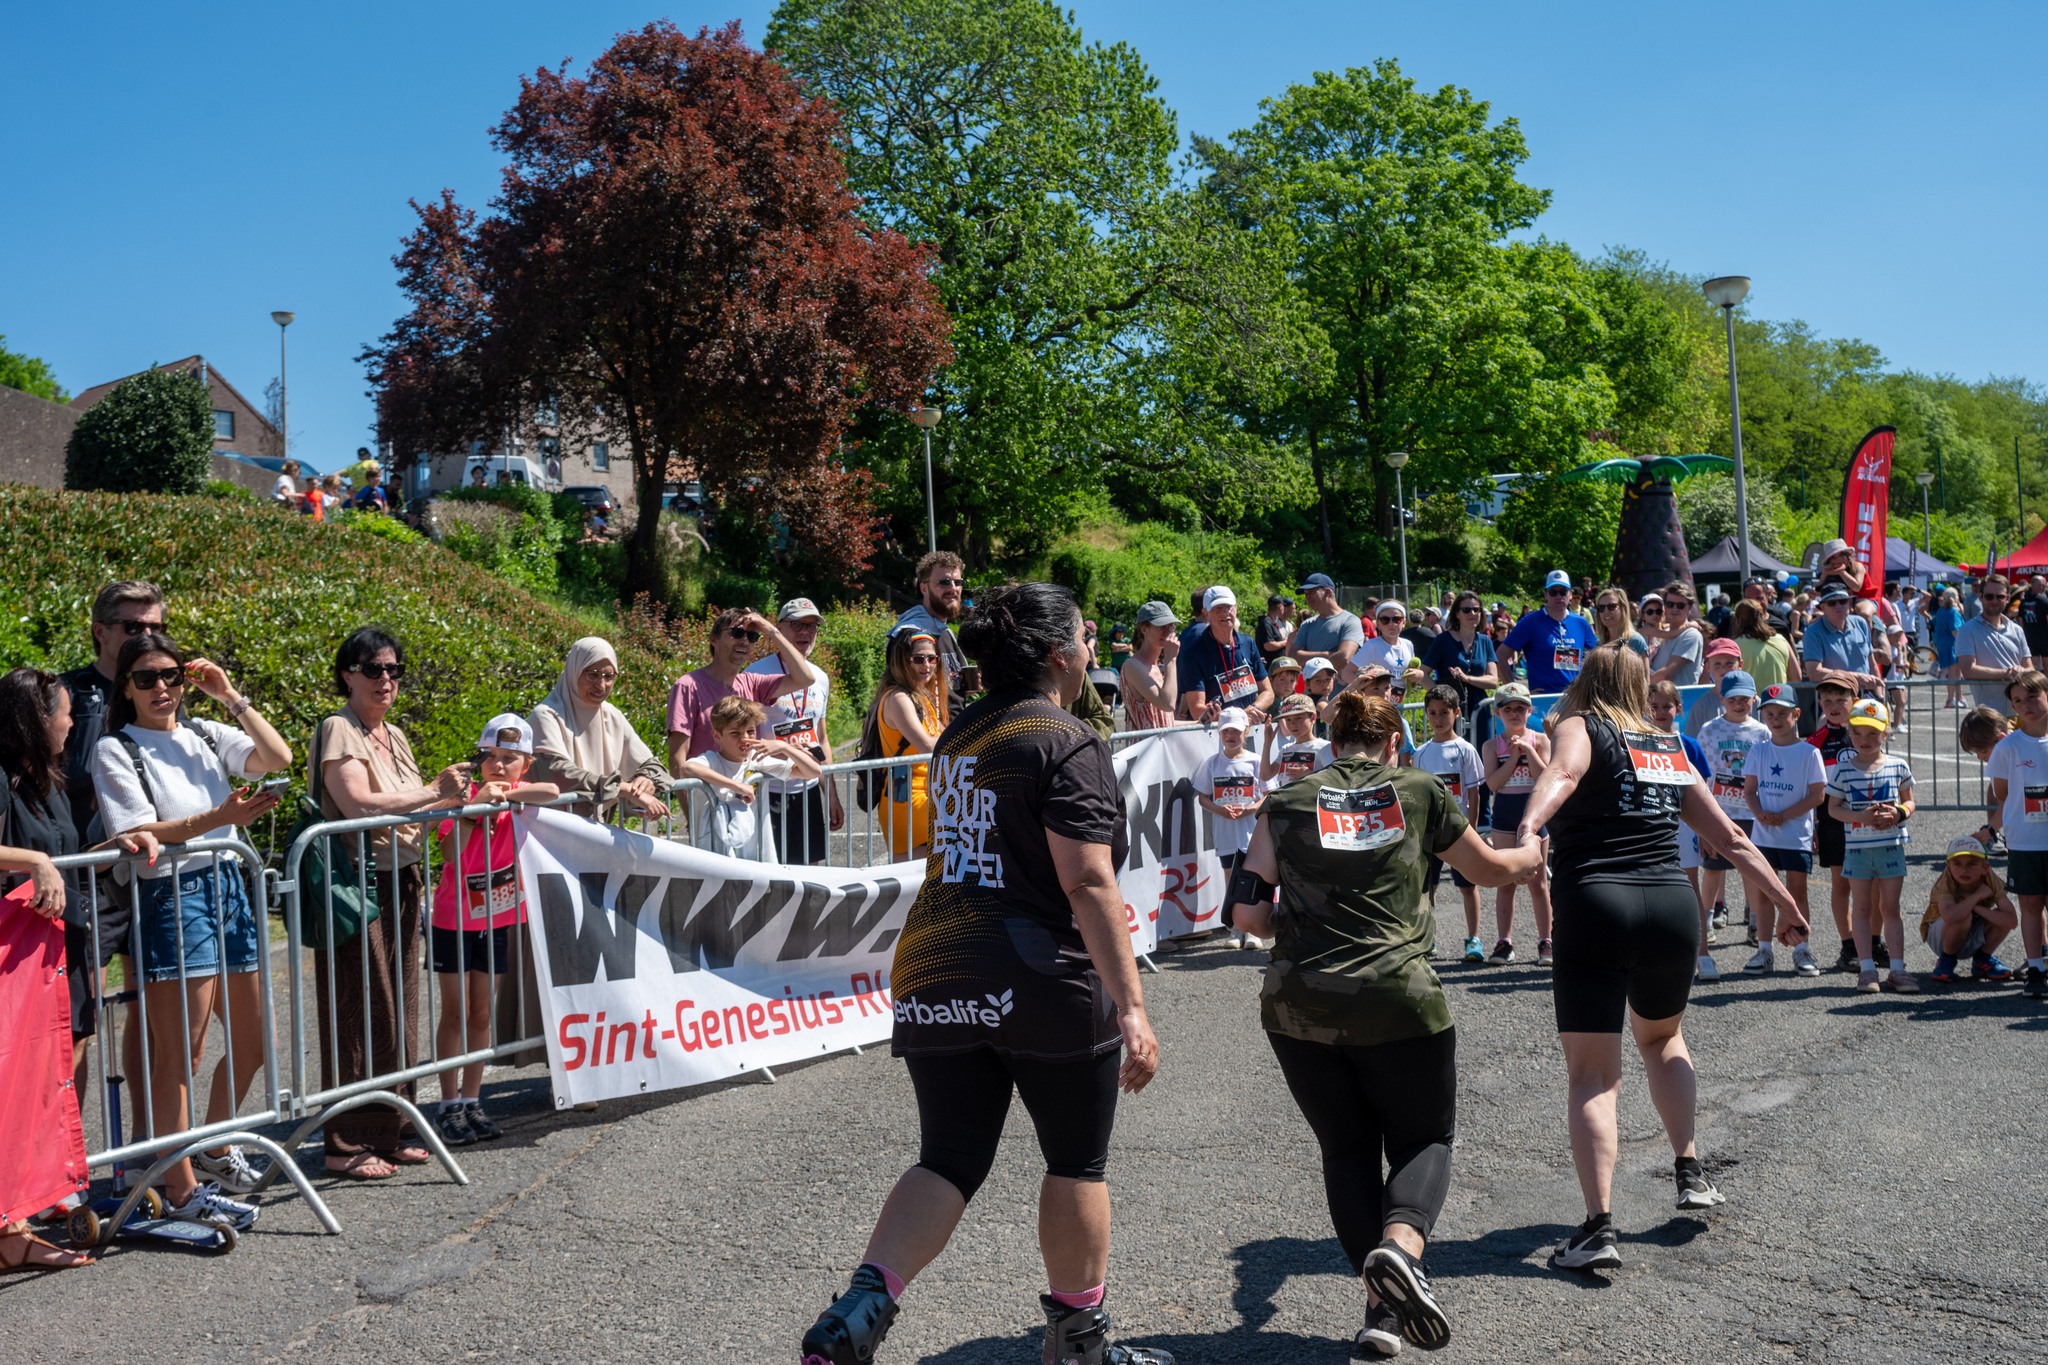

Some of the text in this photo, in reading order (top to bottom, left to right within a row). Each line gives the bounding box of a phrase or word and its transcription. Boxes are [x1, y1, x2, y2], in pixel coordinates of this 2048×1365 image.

[931, 755, 978, 793] LIVE
[1641, 752, 1675, 774] 703
[1222, 787, 1245, 798] 630
[1319, 791, 1345, 803] Herbalife
[1759, 780, 1794, 792] ARTHUR
[931, 786, 997, 826] YOUR
[933, 818, 991, 855] BEST
[1333, 812, 1385, 840] 1335
[942, 848, 1006, 888] LIFE!
[893, 995, 1001, 1028] erbalife
